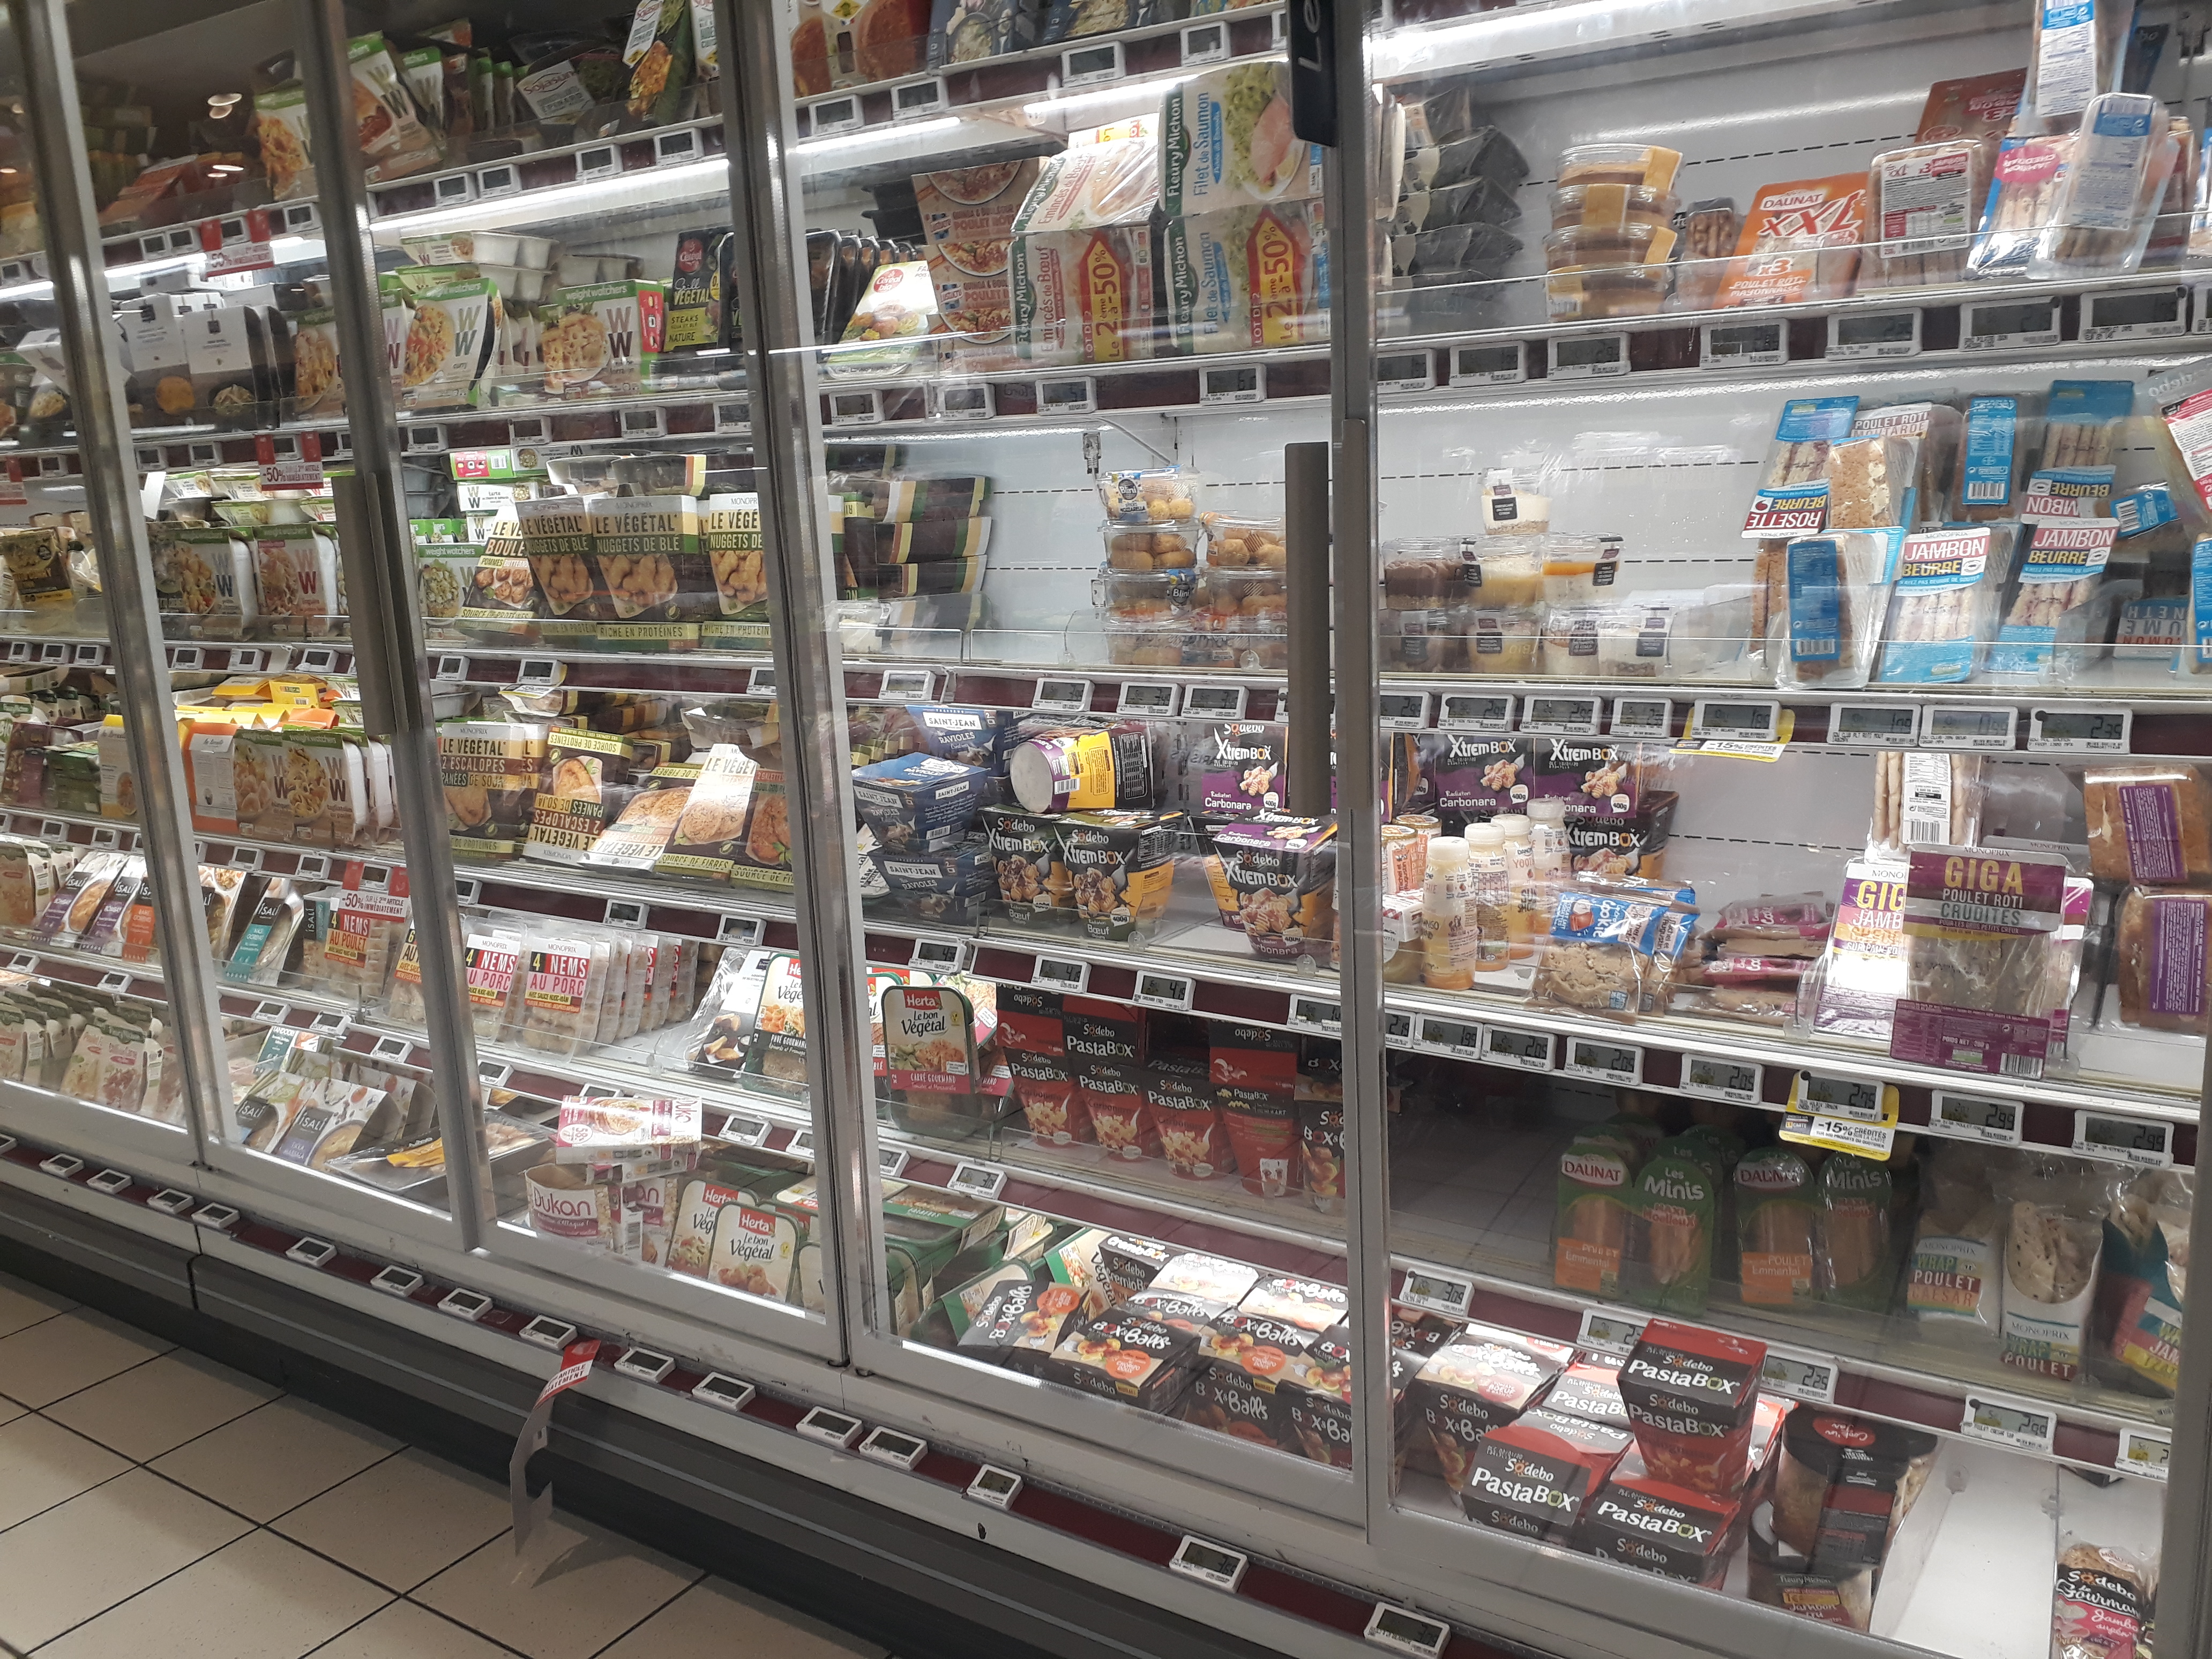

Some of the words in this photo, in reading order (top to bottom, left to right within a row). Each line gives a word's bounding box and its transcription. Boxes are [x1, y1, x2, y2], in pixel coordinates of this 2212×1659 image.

[1195, 91, 1209, 150] Saumon
[1194, 165, 1208, 197] Filet
[1763, 193, 1823, 209] DAUNAT
[1201, 231, 1215, 290] Saumon
[455, 329, 478, 357] W
[609, 331, 633, 358] W
[668, 332, 696, 343] NATURE
[1855, 417, 1897, 429] POULET
[1119, 485, 1138, 495] Blini
[2051, 482, 2111, 497] BEURRE
[468, 497, 481, 508] W
[1772, 495, 1826, 510] BEURRE
[521, 517, 533, 535] LE
[595, 516, 610, 533] LE
[711, 512, 724, 529] LE
[1747, 511, 1822, 528] ROSETTE
[492, 522, 506, 536] LE
[2034, 527, 2117, 547] JAMBON
[559, 539, 569, 552] DE
[596, 537, 640, 553] NUGGETS
[644, 537, 656, 552] DE
[710, 534, 749, 549] NUGGETS
[751, 534, 763, 548] DE
[1904, 538, 1986, 561] JAMBON
[2028, 550, 2089, 564] BEURRE
[1903, 561, 1961, 577] BEURRE
[1173, 588, 1190, 600] Blini
[599, 626, 625, 638] RICHE
[627, 626, 636, 637] EN
[638, 624, 683, 637] PROTÉINES
[443, 739, 454, 753] LE
[584, 739, 593, 750] DE
[594, 739, 617, 753] SOURCE
[938, 732, 976, 744] RAVIOLES
[442, 757, 447, 769] 2
[450, 757, 505, 772] ESCALOPES
[705, 759, 717, 772] LE
[469, 774, 479, 786] DE
[329, 778, 347, 802] W
[559, 796, 570, 811] DE
[572, 801, 604, 817] PANÉES
[1205, 798, 1252, 811] Carbonara
[1439, 797, 1496, 808] Carbonara
[534, 810, 589, 832] ESCALOPES
[594, 820, 600, 832] 2
[997, 817, 1036, 833] Sodebo
[1072, 829, 1109, 844] Sodebo
[1217, 833, 1272, 848] Carbonara
[1237, 850, 1280, 867] Sodebo
[1945, 856, 2023, 894] GIGA
[902, 879, 938, 890] RAVIOLES
[342, 893, 364, 909] -50%
[386, 898, 404, 906] ARTICLE
[1942, 888, 1989, 905] POULET
[331, 914, 337, 928] 4
[343, 914, 369, 936] NEMS
[330, 931, 339, 945] AU
[341, 933, 367, 952] POULET
[408, 930, 415, 943] 6
[466, 952, 473, 966] 4
[482, 952, 515, 974] NEMS
[532, 953, 541, 972] 4
[551, 954, 587, 978] NEMS
[483, 973, 509, 991] PORC
[530, 974, 547, 990] AU
[553, 976, 585, 996] PORC
[906, 993, 936, 1007] Herta
[1013, 994, 1043, 1007] Sodebo
[914, 1011, 922, 1021] Le
[923, 1011, 938, 1021] bon
[901, 1018, 946, 1037] Végétal
[1083, 1023, 1115, 1037] Sodebo
[1235, 1029, 1272, 1042] Sodebo
[771, 1034, 783, 1044] PAVÉ
[1021, 1052, 1051, 1065] Sodebo
[910, 1072, 927, 1083] CARRÉ
[928, 1073, 956, 1084] GOURMAND
[1090, 1064, 1121, 1078] Sodebo
[1160, 1079, 1192, 1094] Sodebo
[1818, 1121, 1852, 1137] -15%
[1854, 1127, 1887, 1139] CRÉDITÉS
[1564, 1163, 1621, 1182] DAUNAT
[1665, 1167, 1684, 1180] Les
[1644, 1175, 1705, 1201] Minis
[534, 1187, 591, 1217] Dukan
[741, 1215, 771, 1230] Herta
[744, 1233, 751, 1245] Le
[753, 1235, 768, 1246] bon
[730, 1239, 774, 1260] Végétal
[1113, 1257, 1146, 1277] Sodebo
[1768, 1254, 1810, 1266] POULET
[1917, 1254, 1954, 1270] WRAP
[1914, 1269, 1975, 1290] POULET
[1910, 1287, 1972, 1307] CAESAR
[976, 1295, 1002, 1328] Sodebo
[1122, 1317, 1168, 1334] Sodebo
[2011, 1320, 2069, 1340] MONOPRIX
[558, 1363, 587, 1379] ARTICLE
[1663, 1356, 1714, 1372] Sodebo
[2005, 1354, 2071, 1378] POULET
[1073, 1372, 1116, 1394] Sodebo
[1209, 1367, 1252, 1392] Sodebo
[1440, 1394, 1489, 1420] Sodebo
[1649, 1394, 1699, 1415] Sodebo
[1550, 1423, 1596, 1440] Sodebo
[1505, 1458, 1554, 1482] Sodebo
[1634, 1499, 1686, 1519] Sodebo
[1491, 1509, 1538, 1533] Sodebo
[1617, 1538, 1667, 1564] Sodebo
[2067, 1570, 2135, 1601] Sodebo
